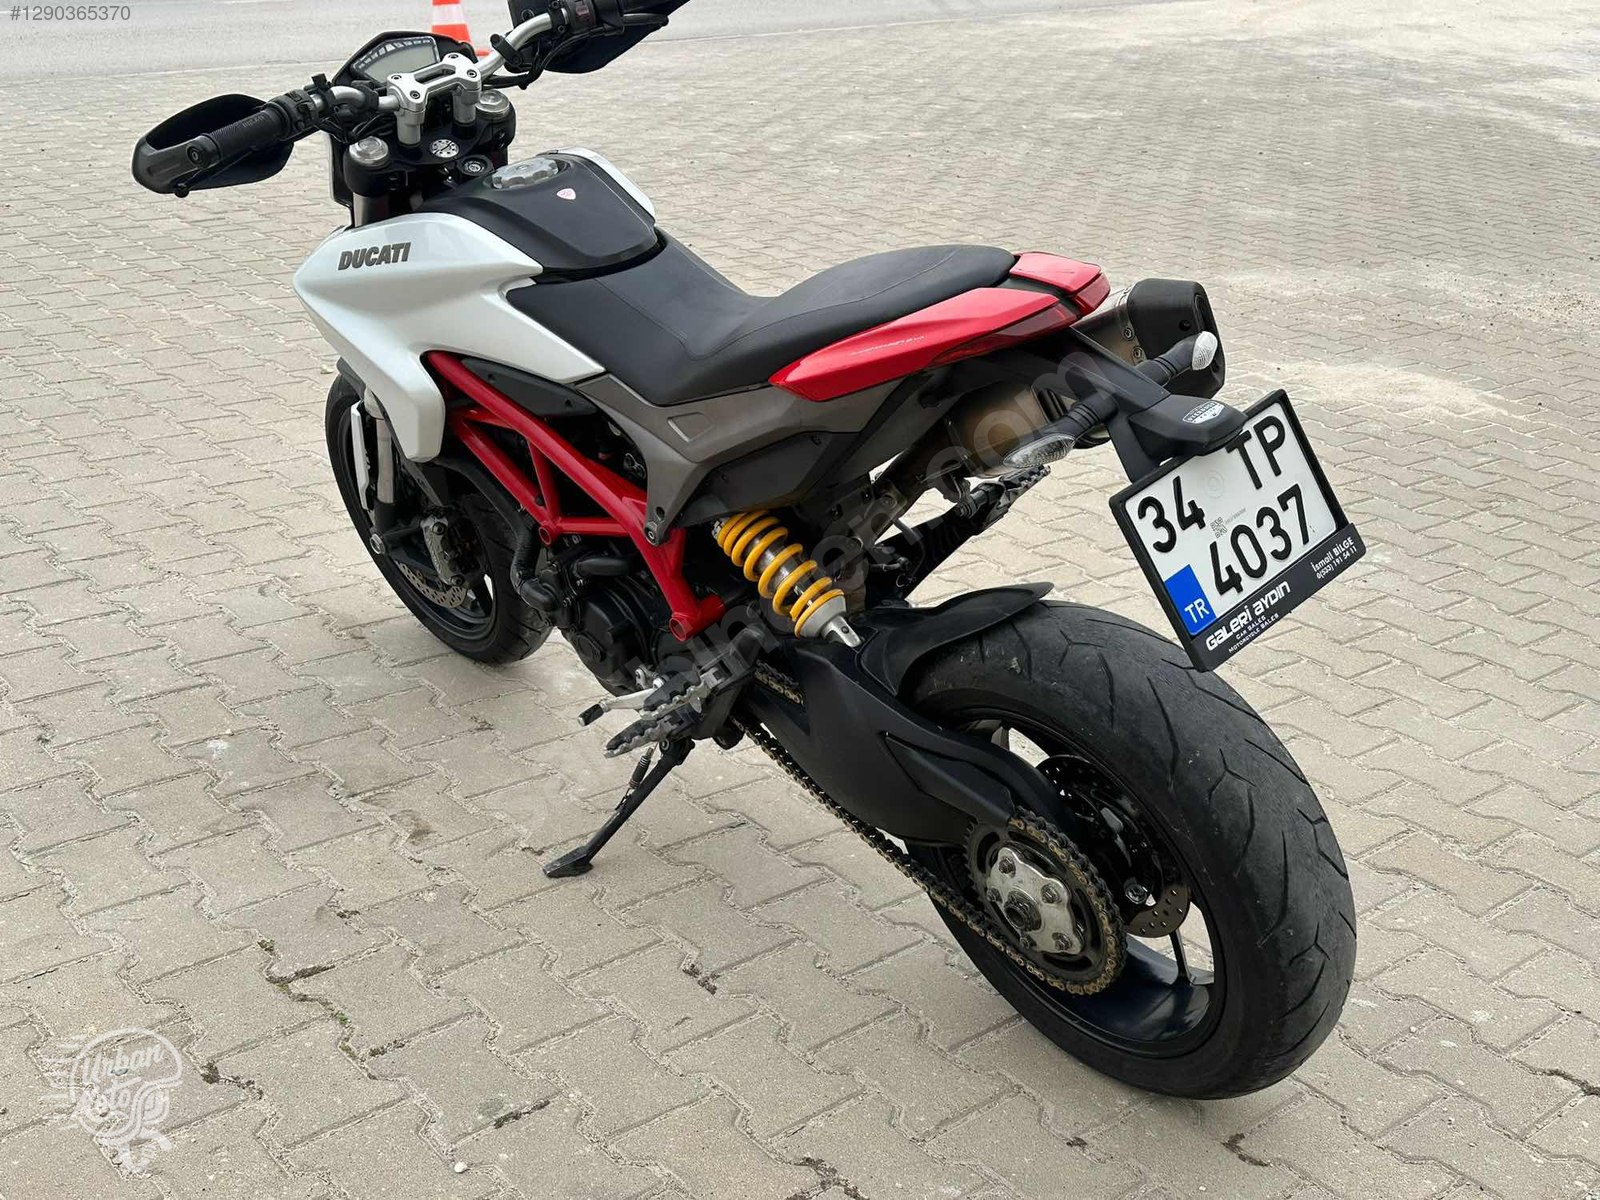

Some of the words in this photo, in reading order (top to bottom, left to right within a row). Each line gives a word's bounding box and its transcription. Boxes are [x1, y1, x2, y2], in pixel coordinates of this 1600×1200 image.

[338, 242, 411, 270] DUCATI
[1137, 475, 1206, 553] 34
[1225, 415, 1286, 490] TP
[1209, 483, 1310, 596] 4037
[1184, 599, 1210, 624] TR
